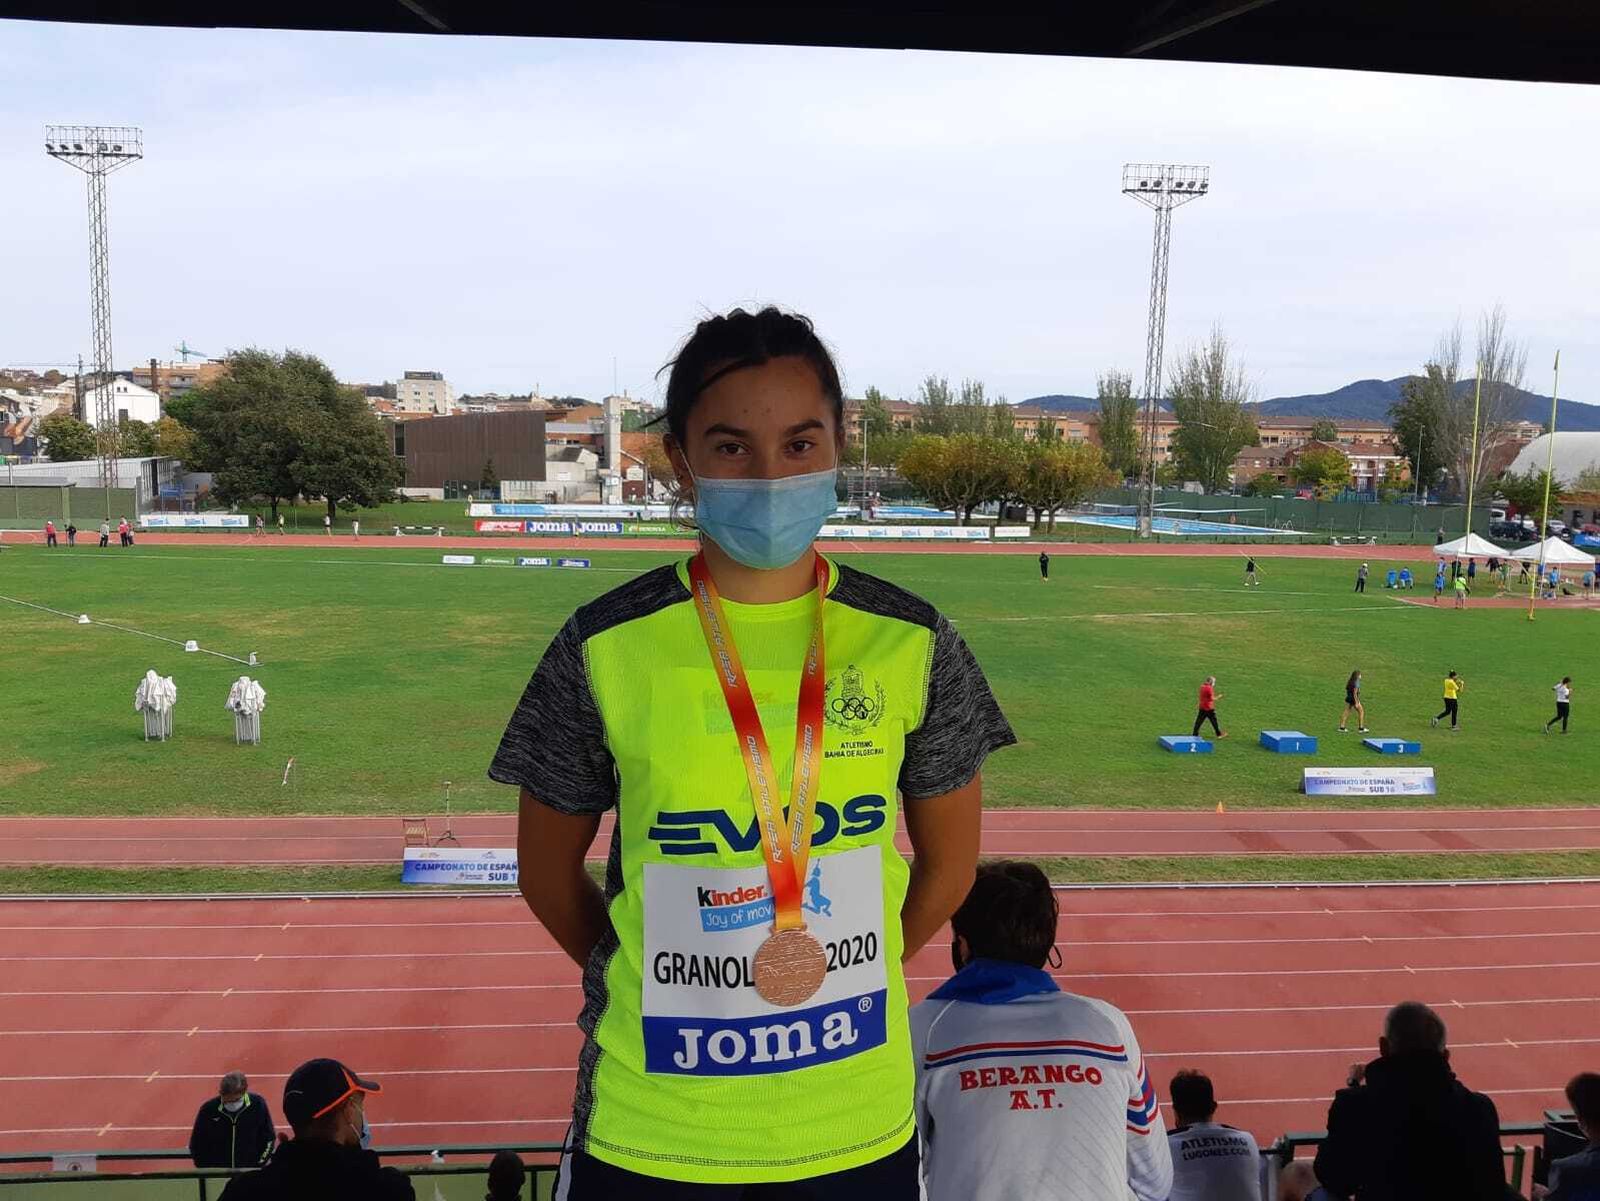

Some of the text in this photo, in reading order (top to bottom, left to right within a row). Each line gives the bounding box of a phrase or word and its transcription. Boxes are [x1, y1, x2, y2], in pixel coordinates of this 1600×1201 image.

[1190, 743, 1197, 751] 2
[1295, 741, 1300, 750] 1
[1398, 744, 1404, 753] 3
[415, 863, 475, 871] CAMPEONATO
[488, 872, 509, 881] SUB
[706, 912, 728, 928] Joy
[731, 909, 744, 924] of
[825, 931, 878, 973] 2020
[960, 1064, 1103, 1092] BERANGO
[1010, 1089, 1063, 1110] A.T.
